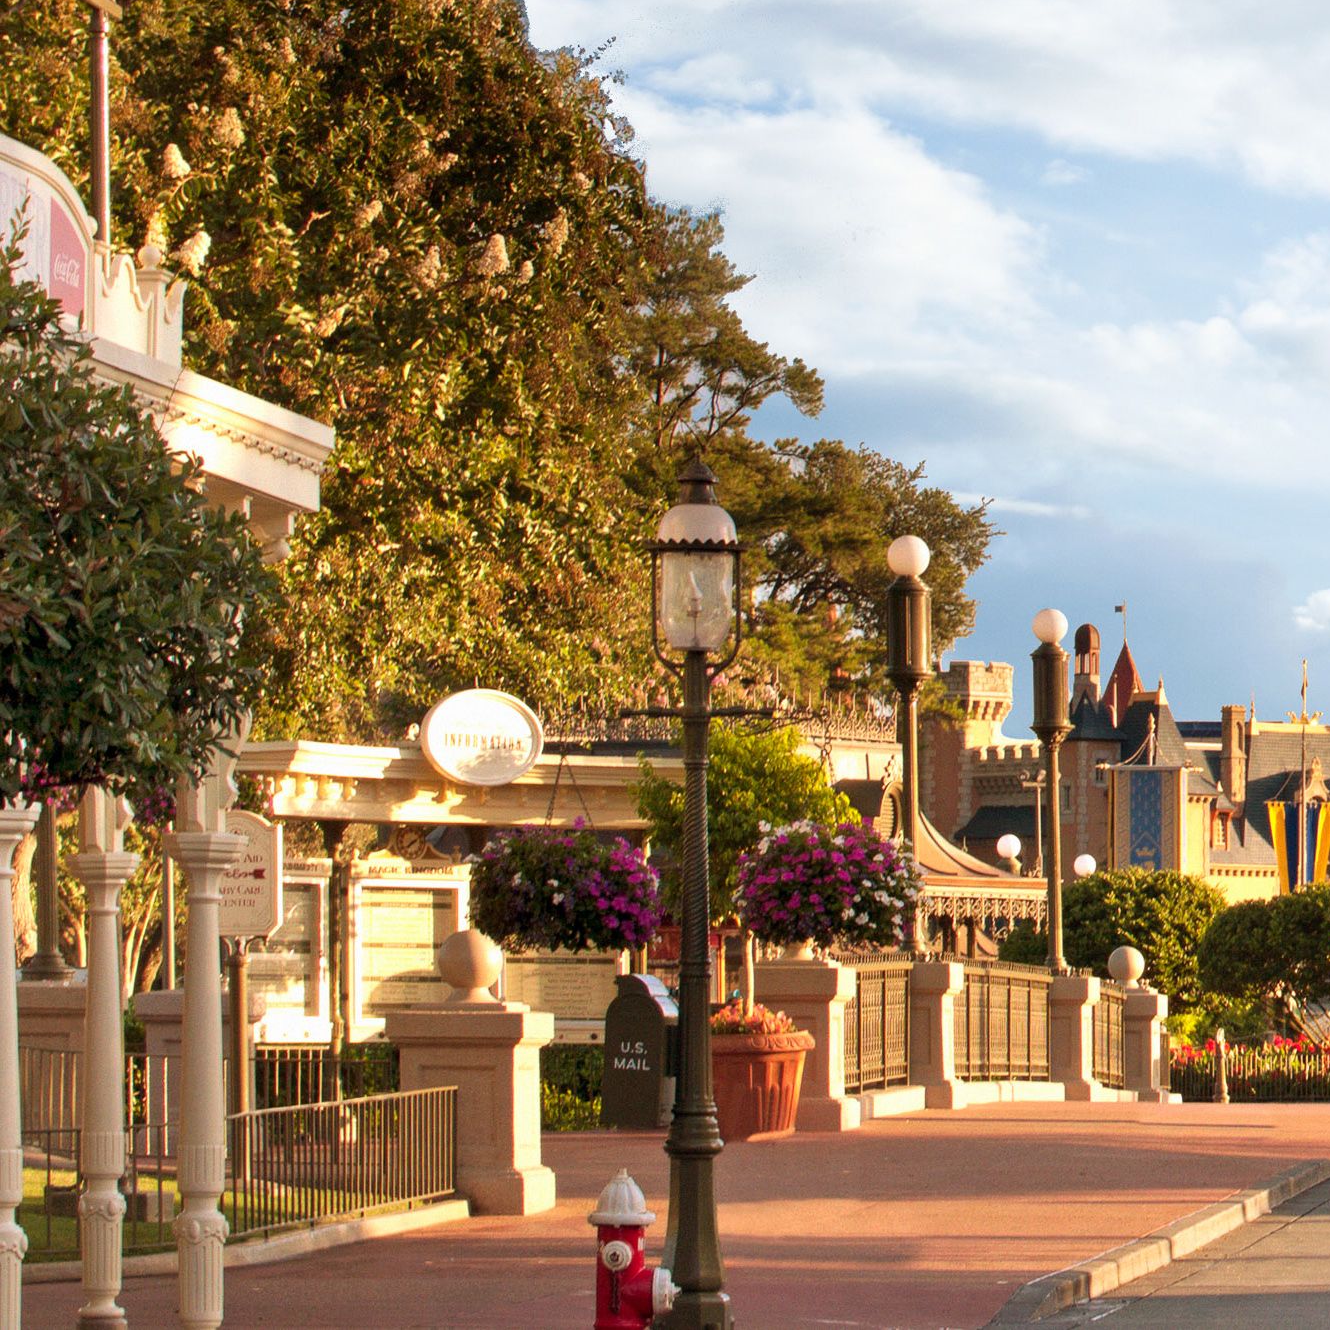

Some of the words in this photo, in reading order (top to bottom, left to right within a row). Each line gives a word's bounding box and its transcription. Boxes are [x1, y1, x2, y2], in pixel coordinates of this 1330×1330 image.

[445, 734, 525, 751] INFORMATION
[369, 866, 397, 874] MAGIC
[405, 866, 453, 875] KINGDOM
[614, 1057, 651, 1071] MAIL
